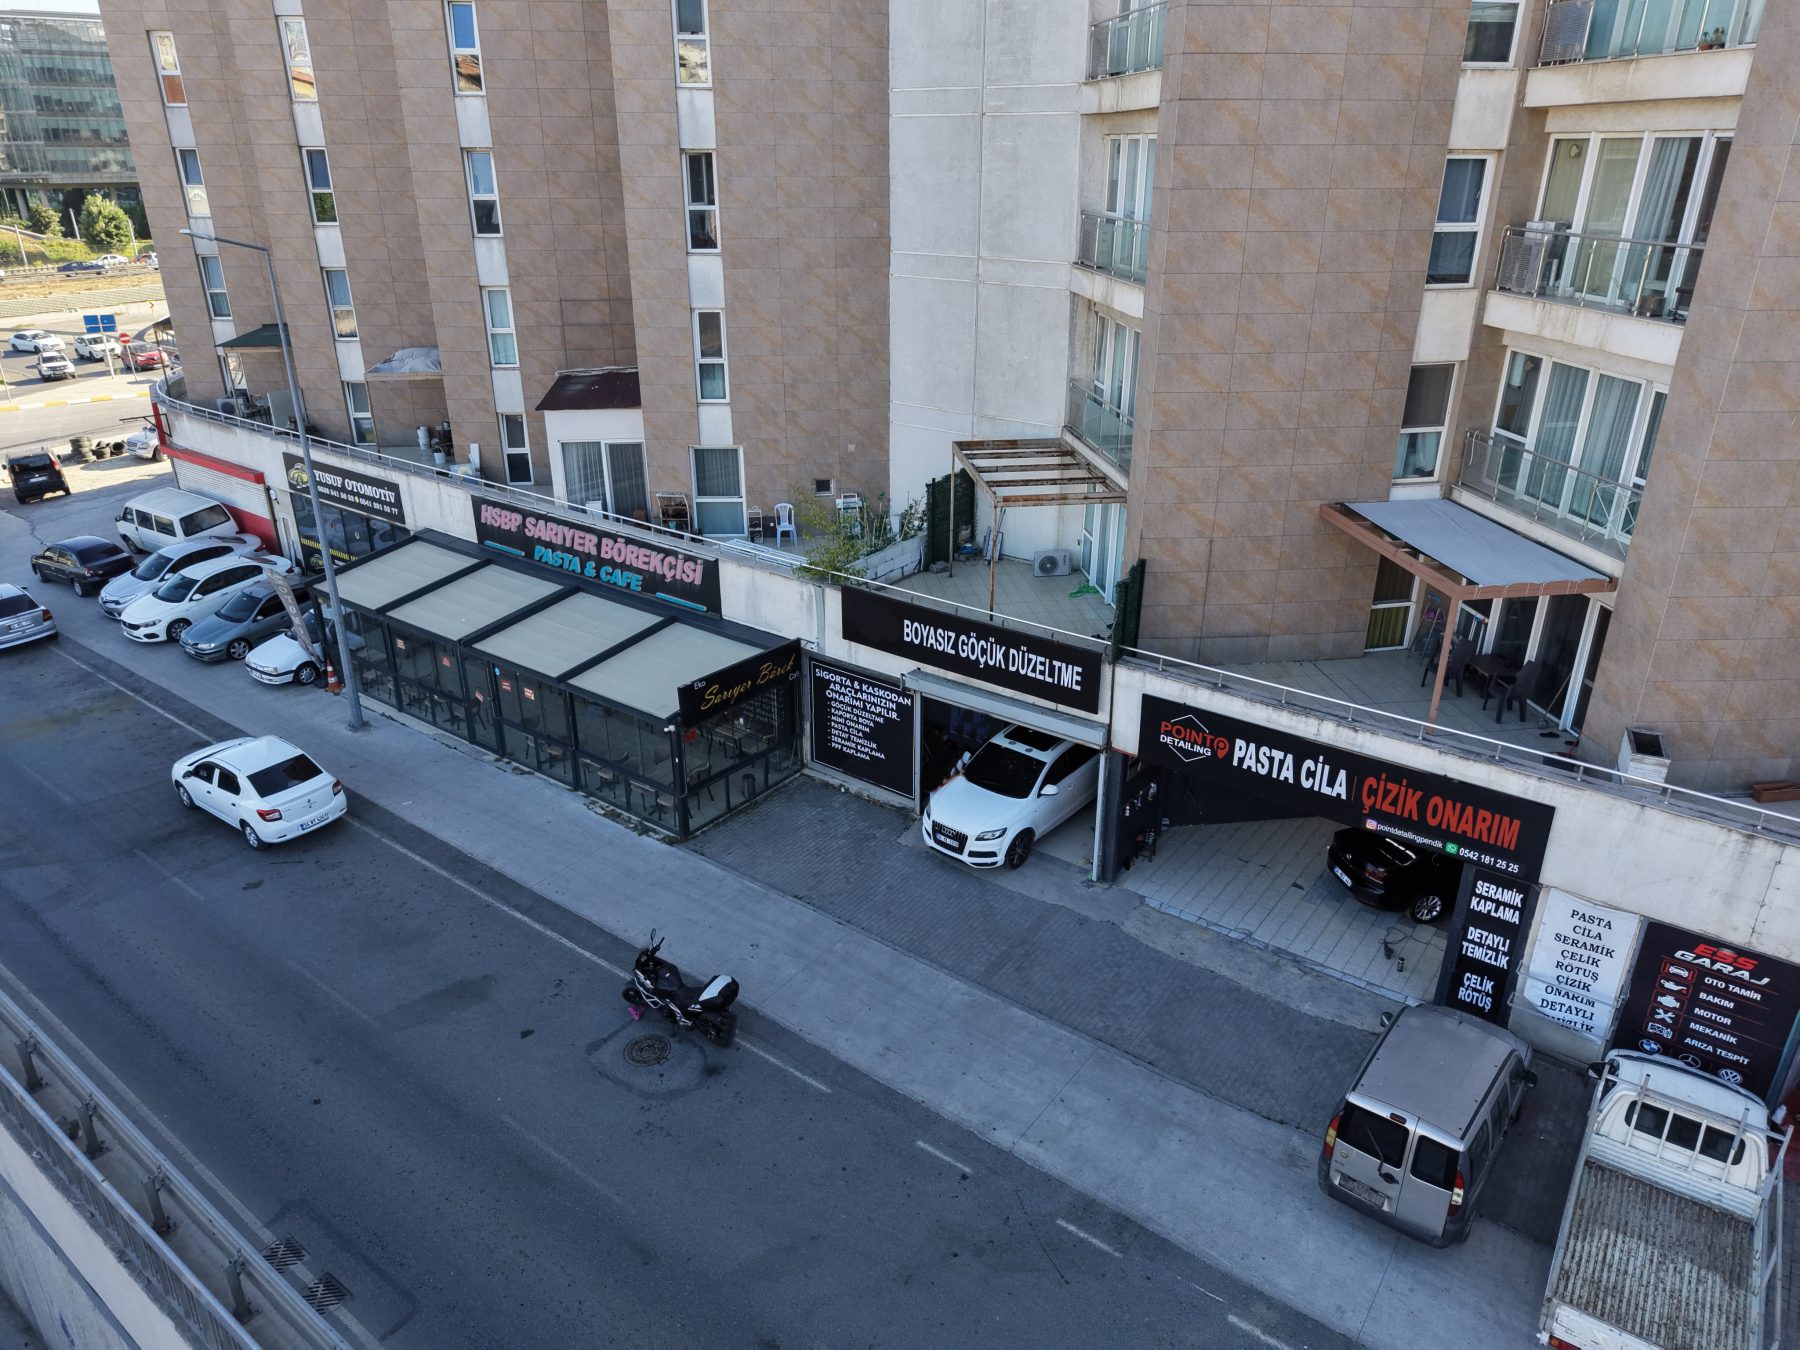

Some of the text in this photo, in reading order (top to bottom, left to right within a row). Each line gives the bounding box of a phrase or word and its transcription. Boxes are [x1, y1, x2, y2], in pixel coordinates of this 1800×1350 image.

[312, 469, 396, 504] YUSUF OTOMOTİV
[480, 504, 704, 585] HSBP SARIYER BÖREKÇİSİ
[534, 545, 643, 592] PASTA & CAFE
[903, 619, 1083, 691] BOYASIZ GÖÇÜK DÜZELTME
[815, 668, 911, 706] SİGORTA & KASKODAN
[829, 682, 897, 711] ARAÇLARINIZIN
[825, 689, 901, 721] ONARIMI YAPILIR.
[831, 700, 885, 724] GÖÇÜK DÜZELTME
[831, 708, 875, 728] KAPORTA BOYA
[831, 721, 863, 737] PASTA CİLA
[846, 720, 870, 733] ONARIM
[831, 728, 878, 750] DETAY TEMİZLİK
[1160, 721, 1214, 748] POINT
[1160, 734, 1212, 757] DETAILING
[831, 735, 886, 760] SERAMİK KAPLAMA
[842, 746, 871, 761] KAPLAMA
[1232, 738, 1521, 850] PASTA CİLA ÇİZİK ONARIM
[1459, 847, 1479, 861] 0542
[1480, 854, 1495, 866] 181
[1496, 859, 1507, 870] 25
[1507, 862, 1519, 873] 25
[1475, 880, 1524, 908] SERAMİK
[1470, 896, 1520, 925] KAPLAMA
[1570, 909, 1613, 930] PASTA
[1467, 926, 1510, 952] DETAYLI
[1572, 924, 1603, 941] CİLA
[1462, 941, 1510, 970] TEMİZLİK
[1554, 932, 1616, 959] SERAMİK
[1692, 943, 1760, 971] ESS
[1560, 949, 1602, 968] ÇELİK
[1673, 950, 1772, 986] GARAJ
[1463, 972, 1495, 994] ÇELİK
[1554, 960, 1600, 983] RÖTUŞ
[1556, 974, 1593, 993] ÇİZİK
[1458, 986, 1493, 1013] RÖTÜŞ
[1544, 984, 1596, 1008] ONARIM
[1698, 991, 1735, 1009] BAKIM
[1704, 976, 1762, 1001] OTO TAMİR
[1540, 998, 1595, 1021] DETAYLI
[1694, 1007, 1732, 1026] MOTOR
[1689, 1022, 1738, 1045] MEKANİK
[1683, 1037, 1750, 1066] ARIZA TESPİT
